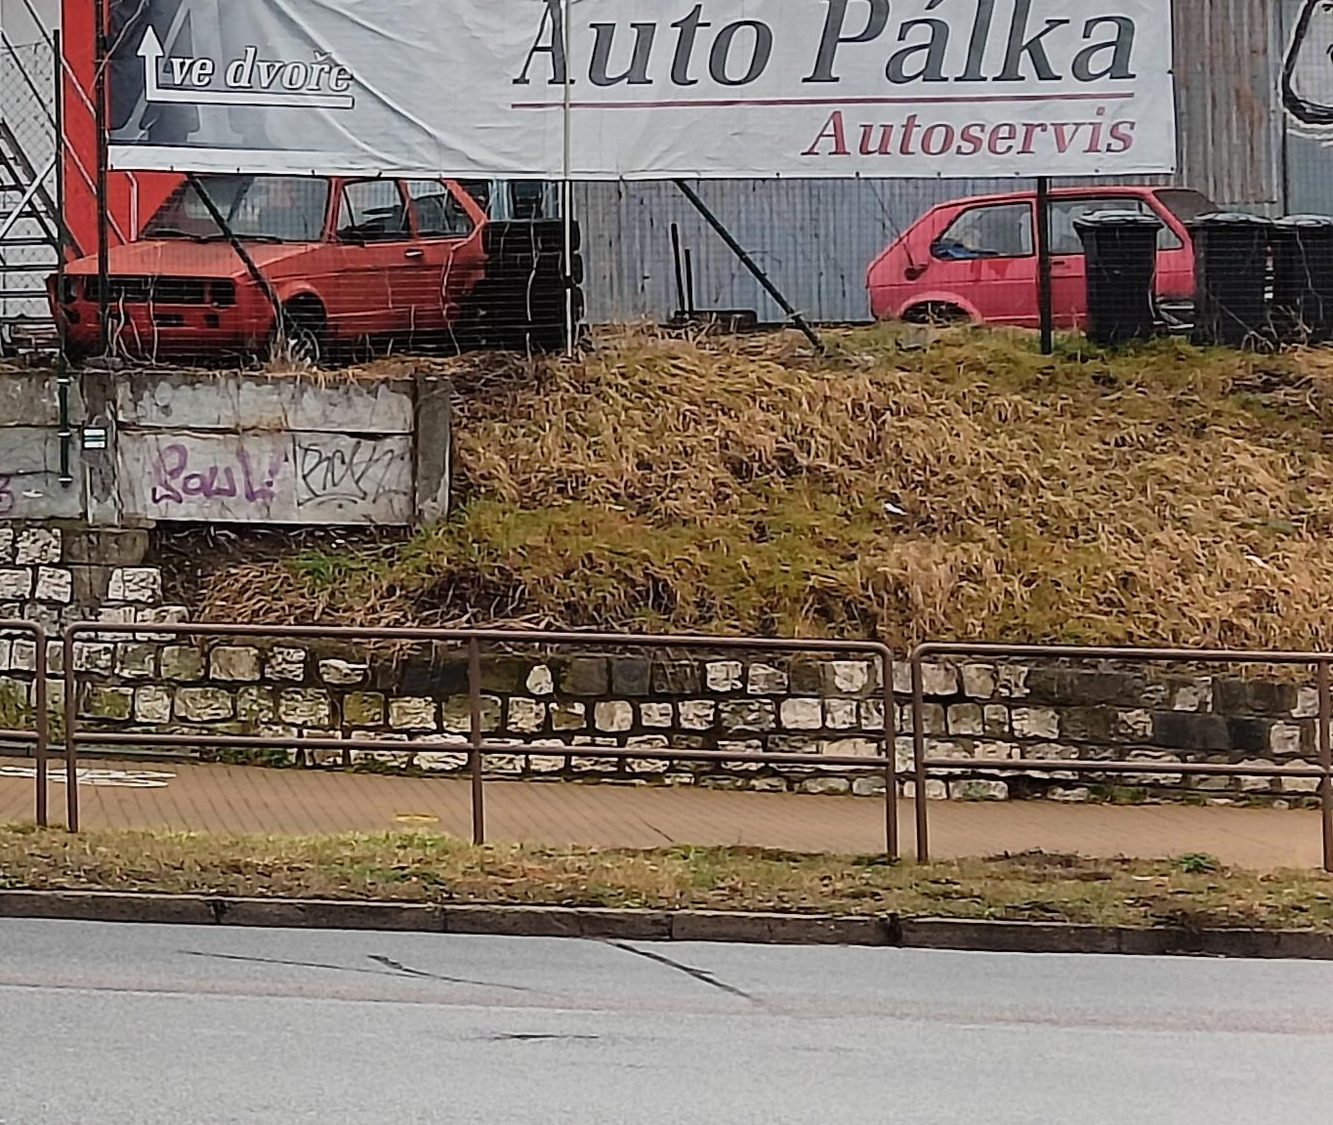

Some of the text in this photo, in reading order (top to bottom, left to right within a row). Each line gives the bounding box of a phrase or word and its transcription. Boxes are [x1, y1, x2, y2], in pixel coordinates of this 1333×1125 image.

[169, 46, 355, 92] ve dvoře
[800, 106, 1136, 156] Autoservis
